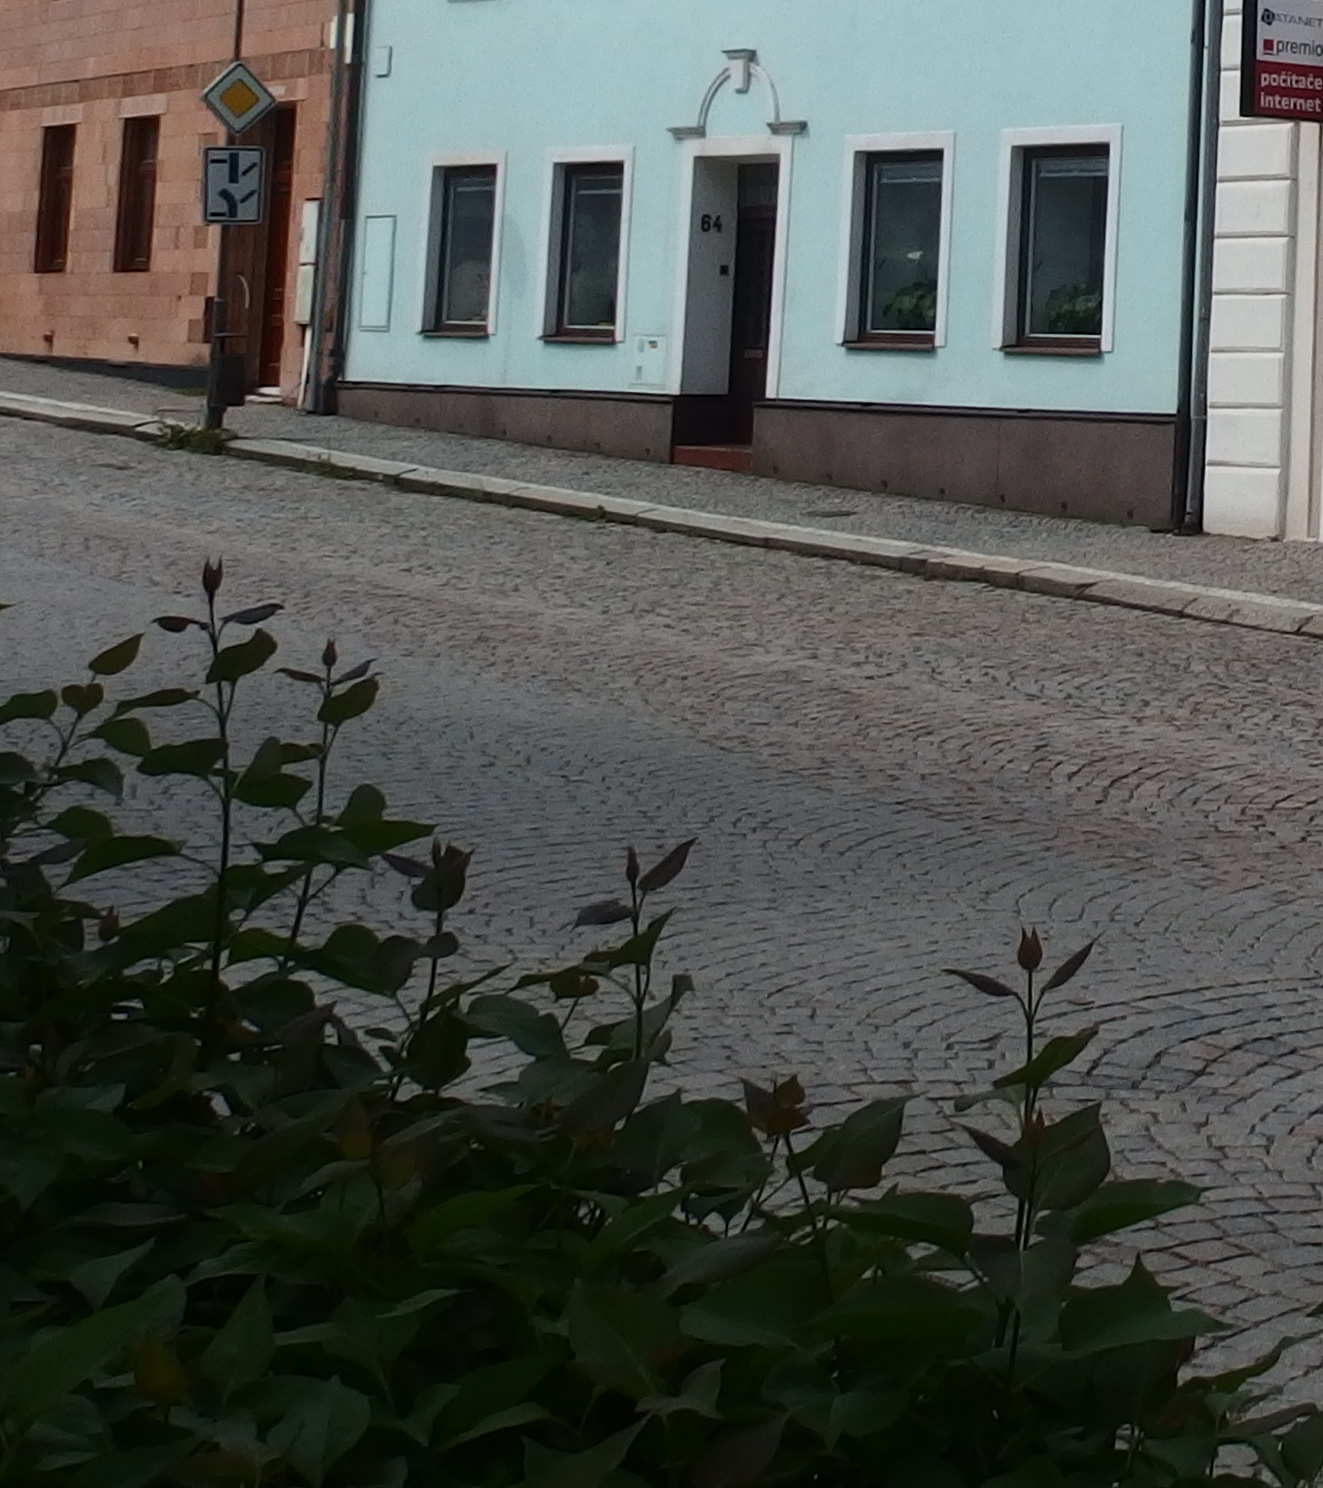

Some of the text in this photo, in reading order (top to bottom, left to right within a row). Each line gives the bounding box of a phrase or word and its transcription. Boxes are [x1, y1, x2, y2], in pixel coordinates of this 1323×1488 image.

[1261, 8, 1323, 27] DATANET
[1276, 39, 1323, 57] premio
[1260, 71, 1323, 90] počítače
[1260, 92, 1322, 112] internet
[701, 214, 722, 233] 64
